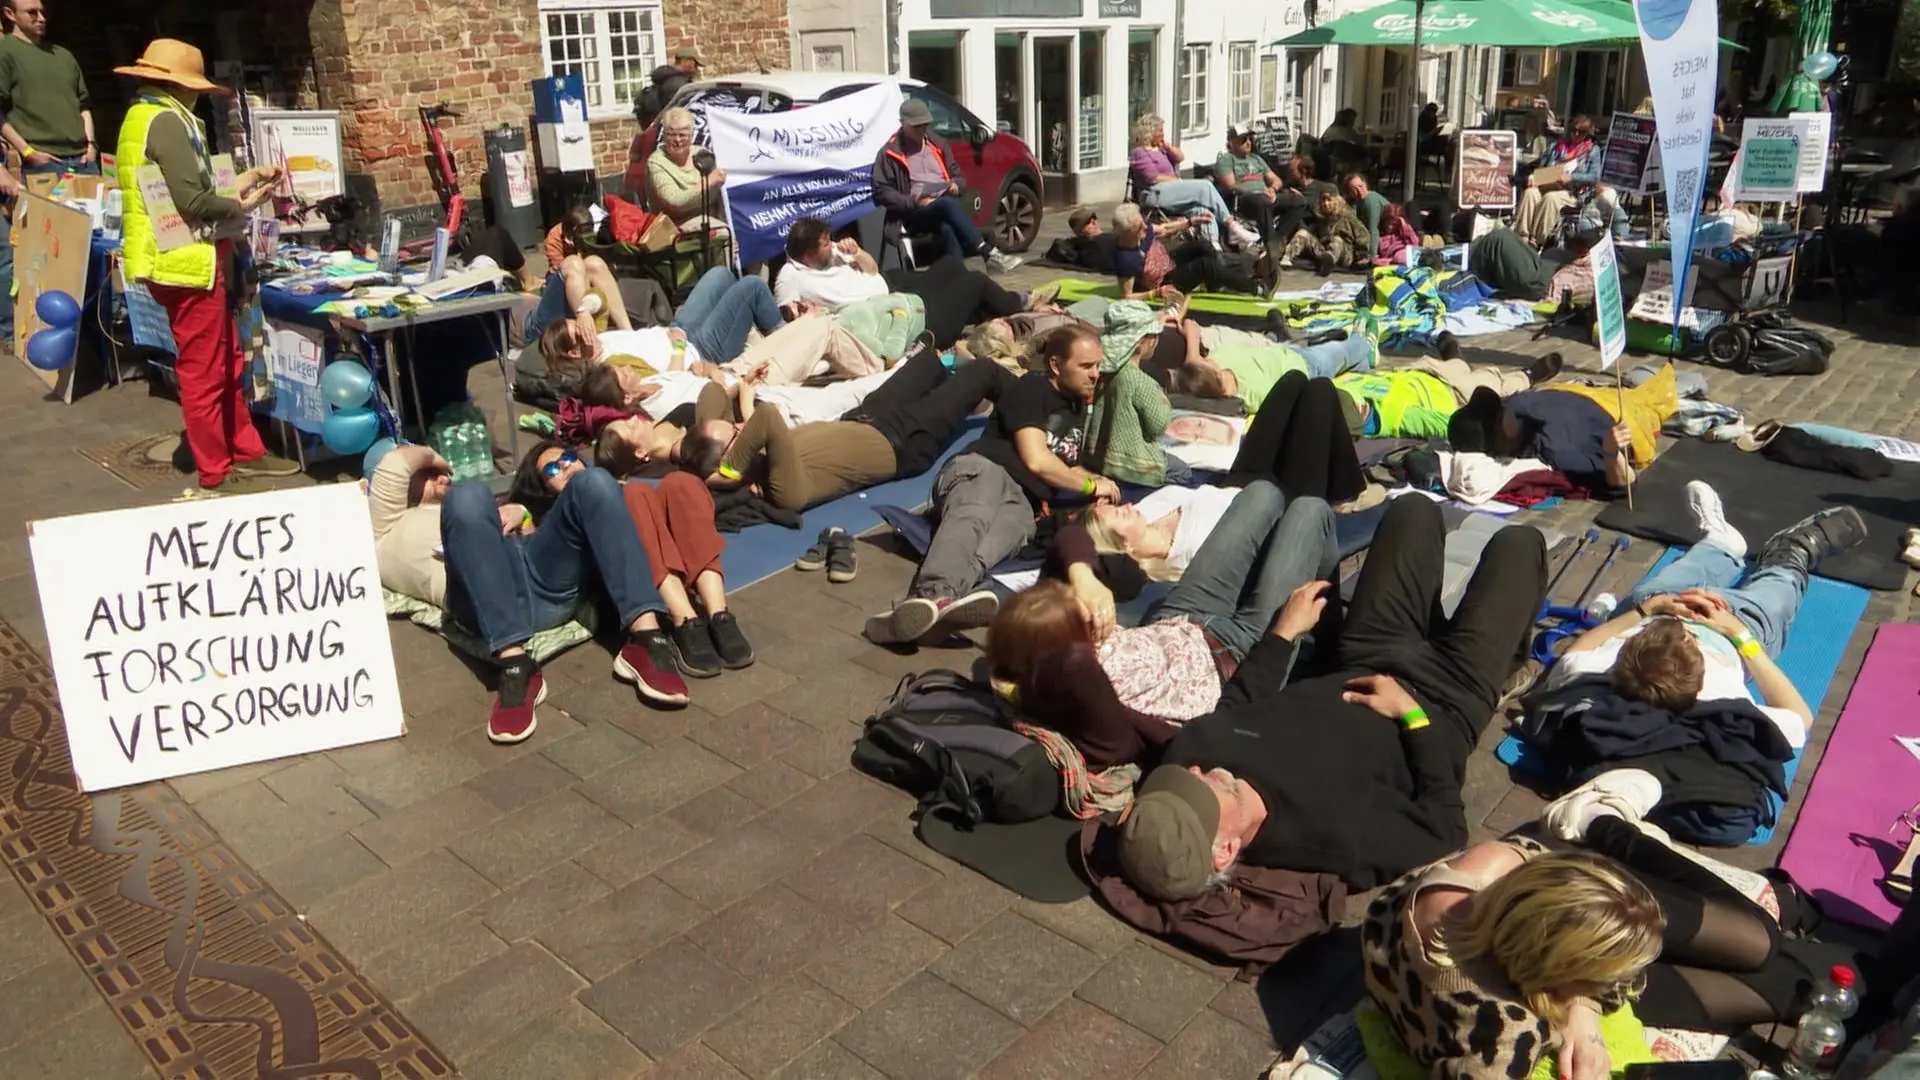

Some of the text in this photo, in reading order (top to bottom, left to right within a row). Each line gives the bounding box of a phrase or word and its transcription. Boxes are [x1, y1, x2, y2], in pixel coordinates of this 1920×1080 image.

[773, 117, 865, 146] MISSING
[748, 201, 797, 230] NEHMT
[762, 187, 779, 202] AN
[145, 513, 296, 576] ME/CFS
[84, 566, 367, 641] AUFKLÄRUNG
[83, 620, 345, 702] FORSCHUNG
[109, 668, 374, 764] VERSORGUNG
